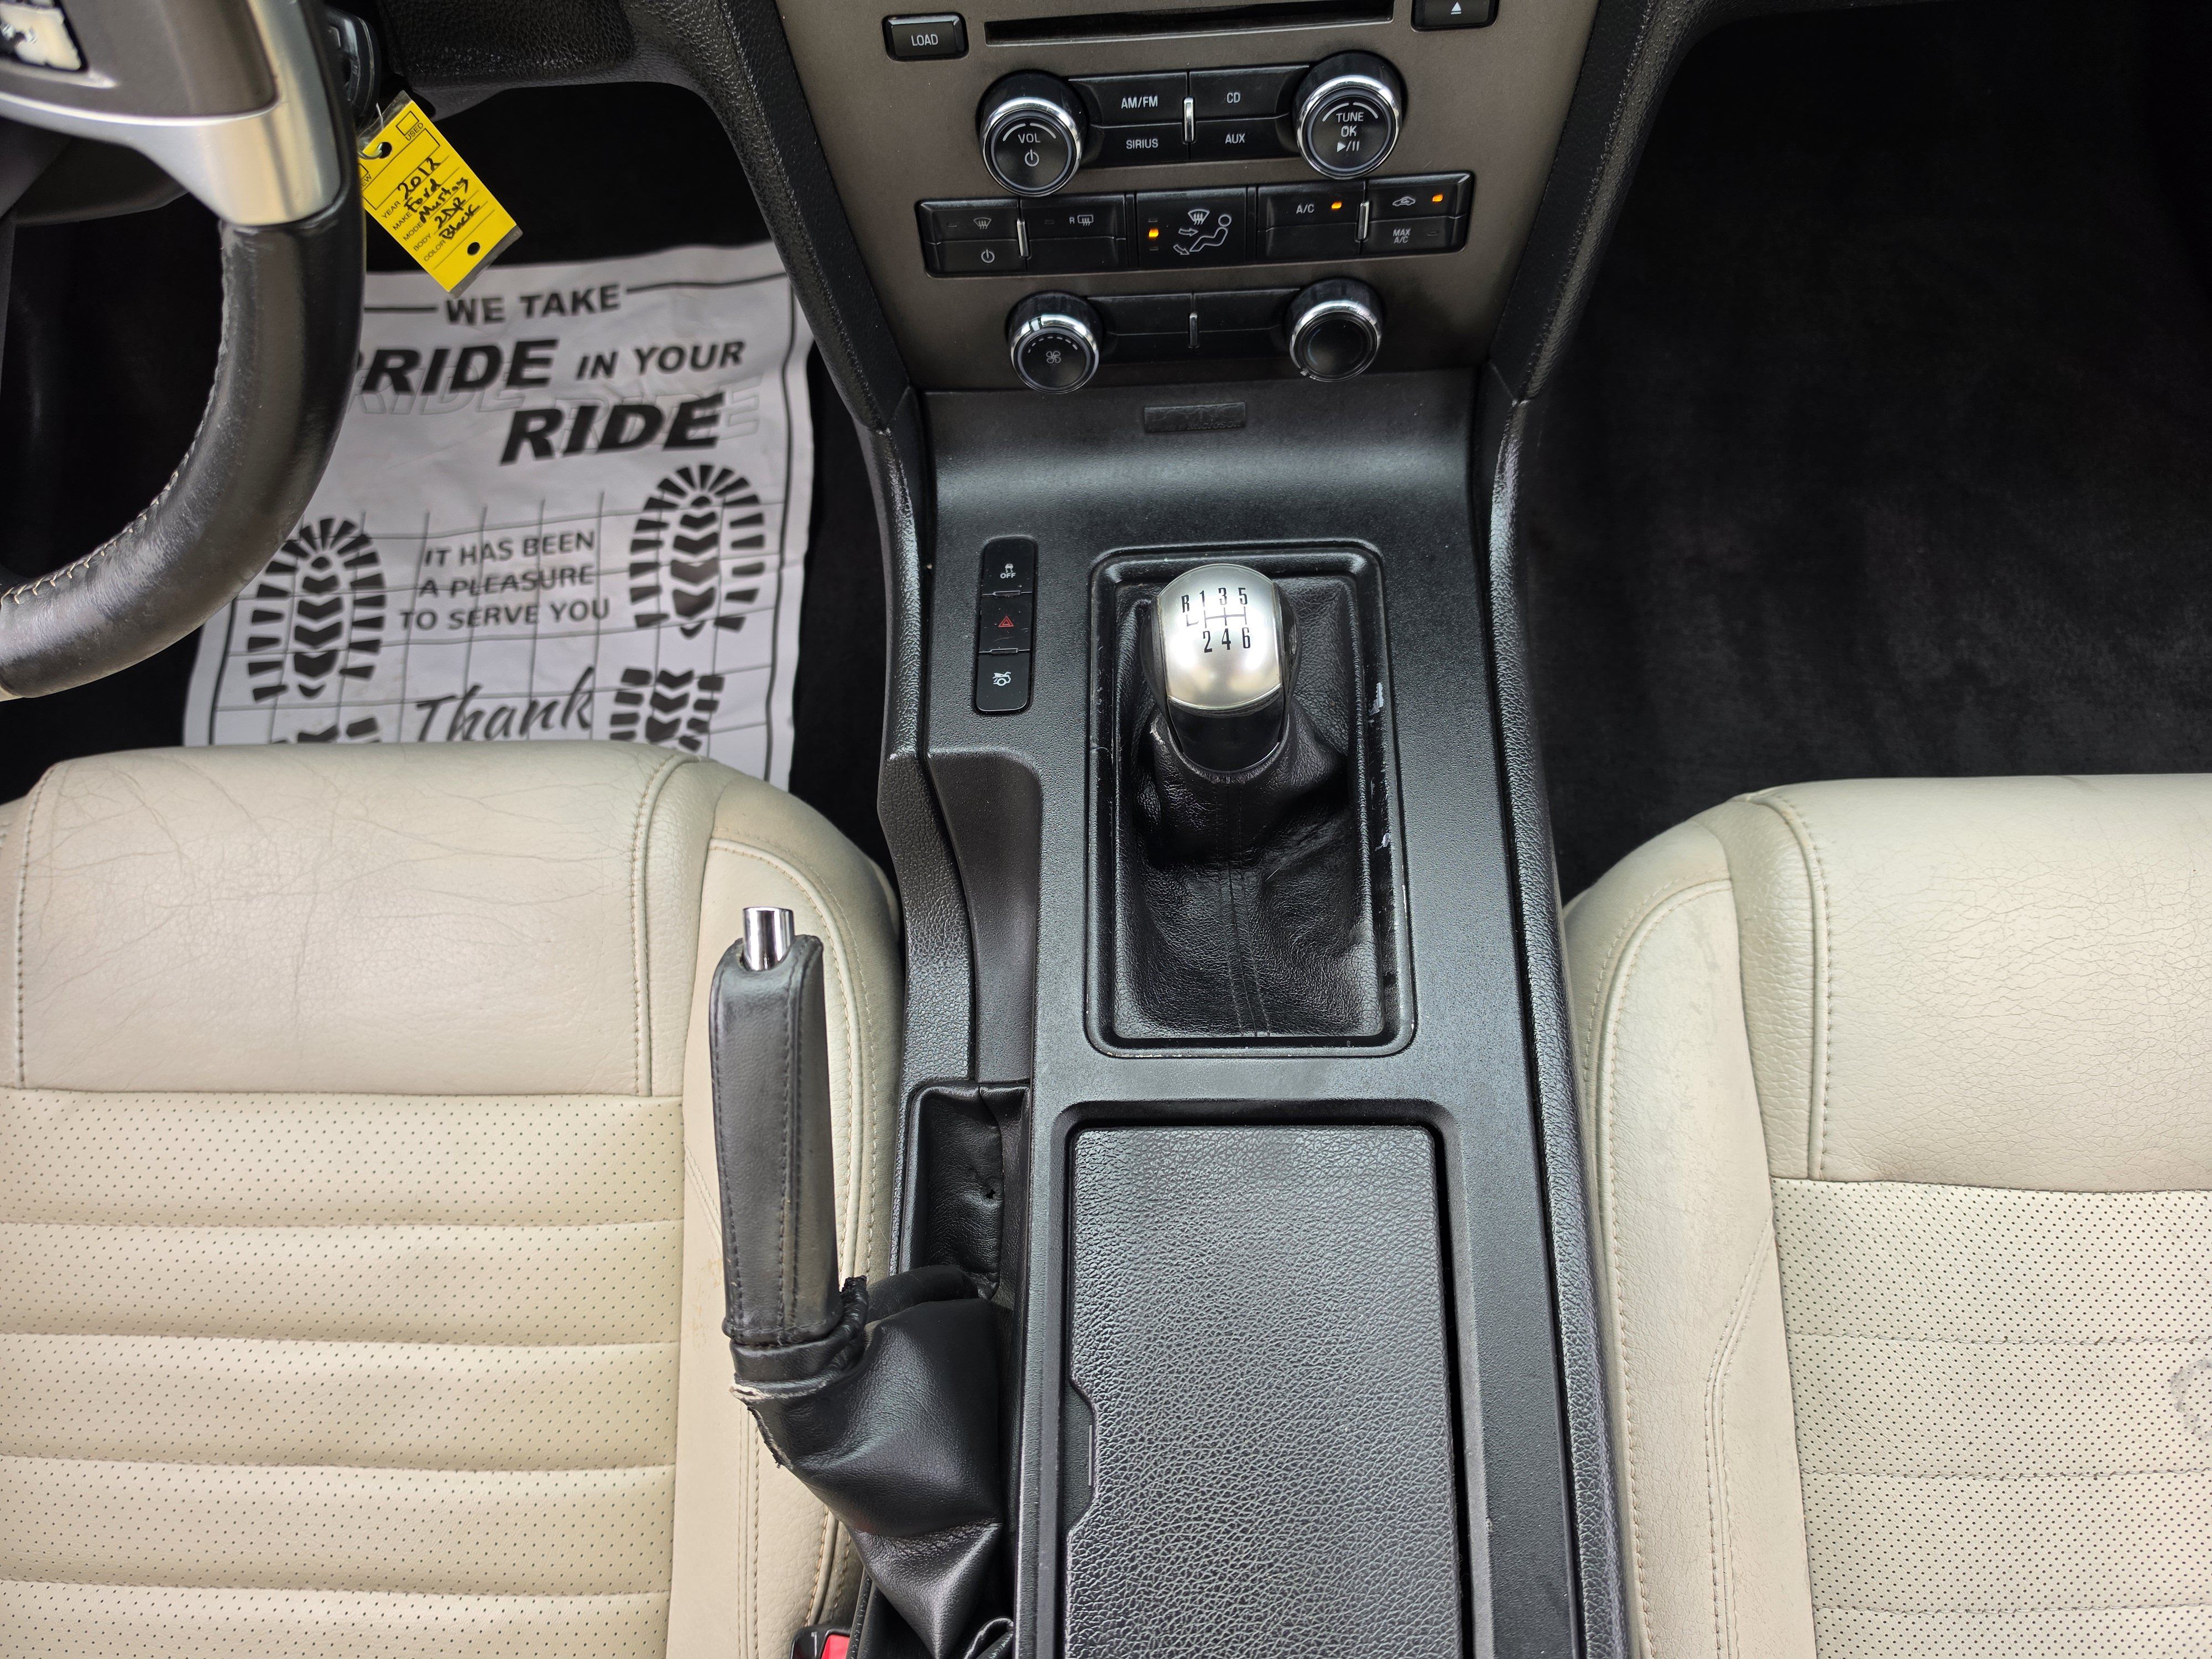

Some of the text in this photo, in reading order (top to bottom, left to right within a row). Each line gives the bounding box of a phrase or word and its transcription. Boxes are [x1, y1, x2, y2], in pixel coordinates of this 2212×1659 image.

[911, 33, 939, 47] LOAD
[1121, 95, 1158, 109] AM/FM
[1227, 92, 1240, 104] CD
[1336, 111, 1364, 123] TUNE
[405, 122, 424, 141] USED
[1018, 133, 1041, 144] VOL
[1225, 133, 1245, 144] AUX
[1340, 126, 1357, 138] OK
[1126, 138, 1159, 149] SIRIUS
[397, 157, 441, 200] 2012
[404, 178, 441, 212] Ford
[382, 201, 401, 219] YEAR
[1296, 204, 1314, 214] A/C
[393, 212, 413, 230] MAKE
[1069, 216, 1076, 225] R
[403, 221, 424, 241] MODE
[1393, 228, 1411, 237] MAX
[1394, 236, 1408, 244] A/C
[413, 233, 432, 251] BODY
[424, 239, 446, 262] COLOR
[445, 284, 623, 326] WE TAKE
[357, 339, 745, 396] RIDE IN YOUR
[500, 391, 726, 467] RIDE
[424, 530, 596, 568] IT HAS BEEN
[419, 564, 596, 598] A PLEASURE
[1181, 587, 1248, 614] R 1 3 5
[400, 598, 611, 630] TO SERVE YOU
[1202, 628, 1251, 653] 2 4 6
[416, 665, 596, 742] Thank
